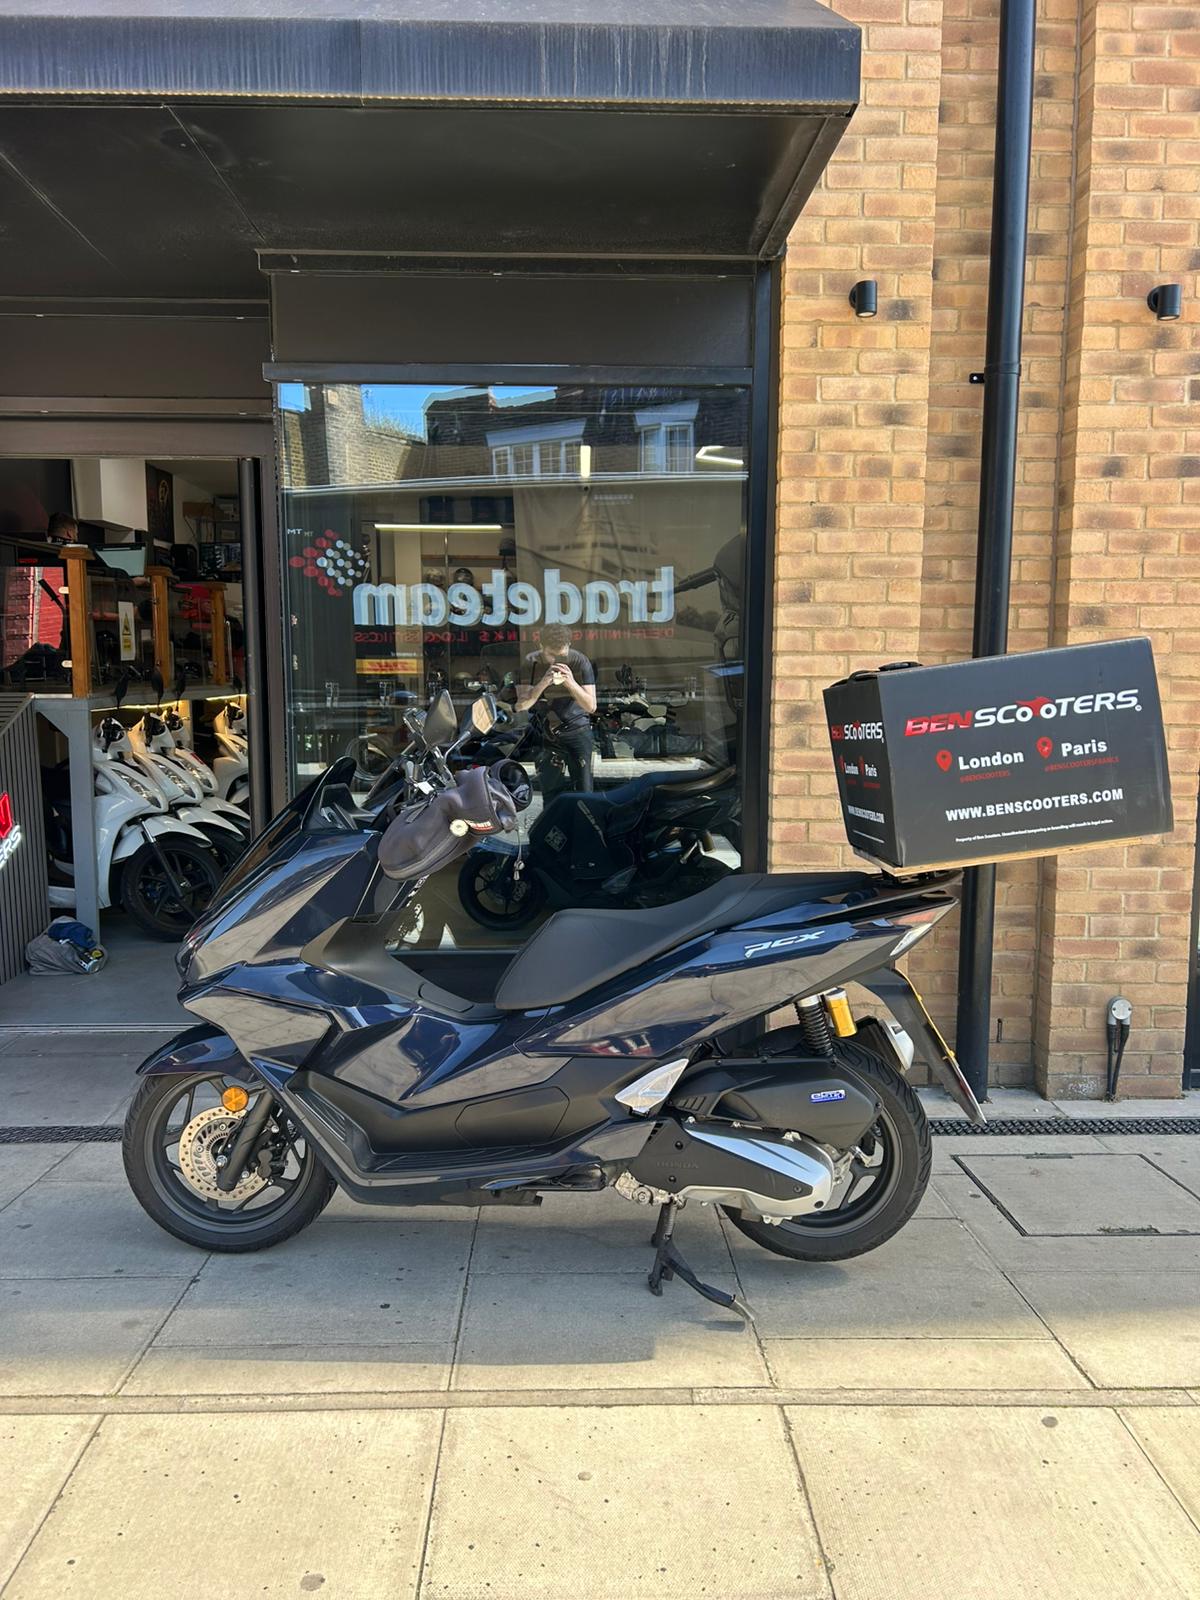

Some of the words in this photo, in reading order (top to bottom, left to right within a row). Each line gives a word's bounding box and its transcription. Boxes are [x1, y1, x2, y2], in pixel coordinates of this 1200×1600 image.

[1061, 738, 1108, 757] Paris
[864, 763, 878, 777] Paris
[958, 750, 1025, 771] London
[945, 788, 1124, 822] WWW.BENSCOOTERS.COM
[744, 930, 825, 959] PCX
